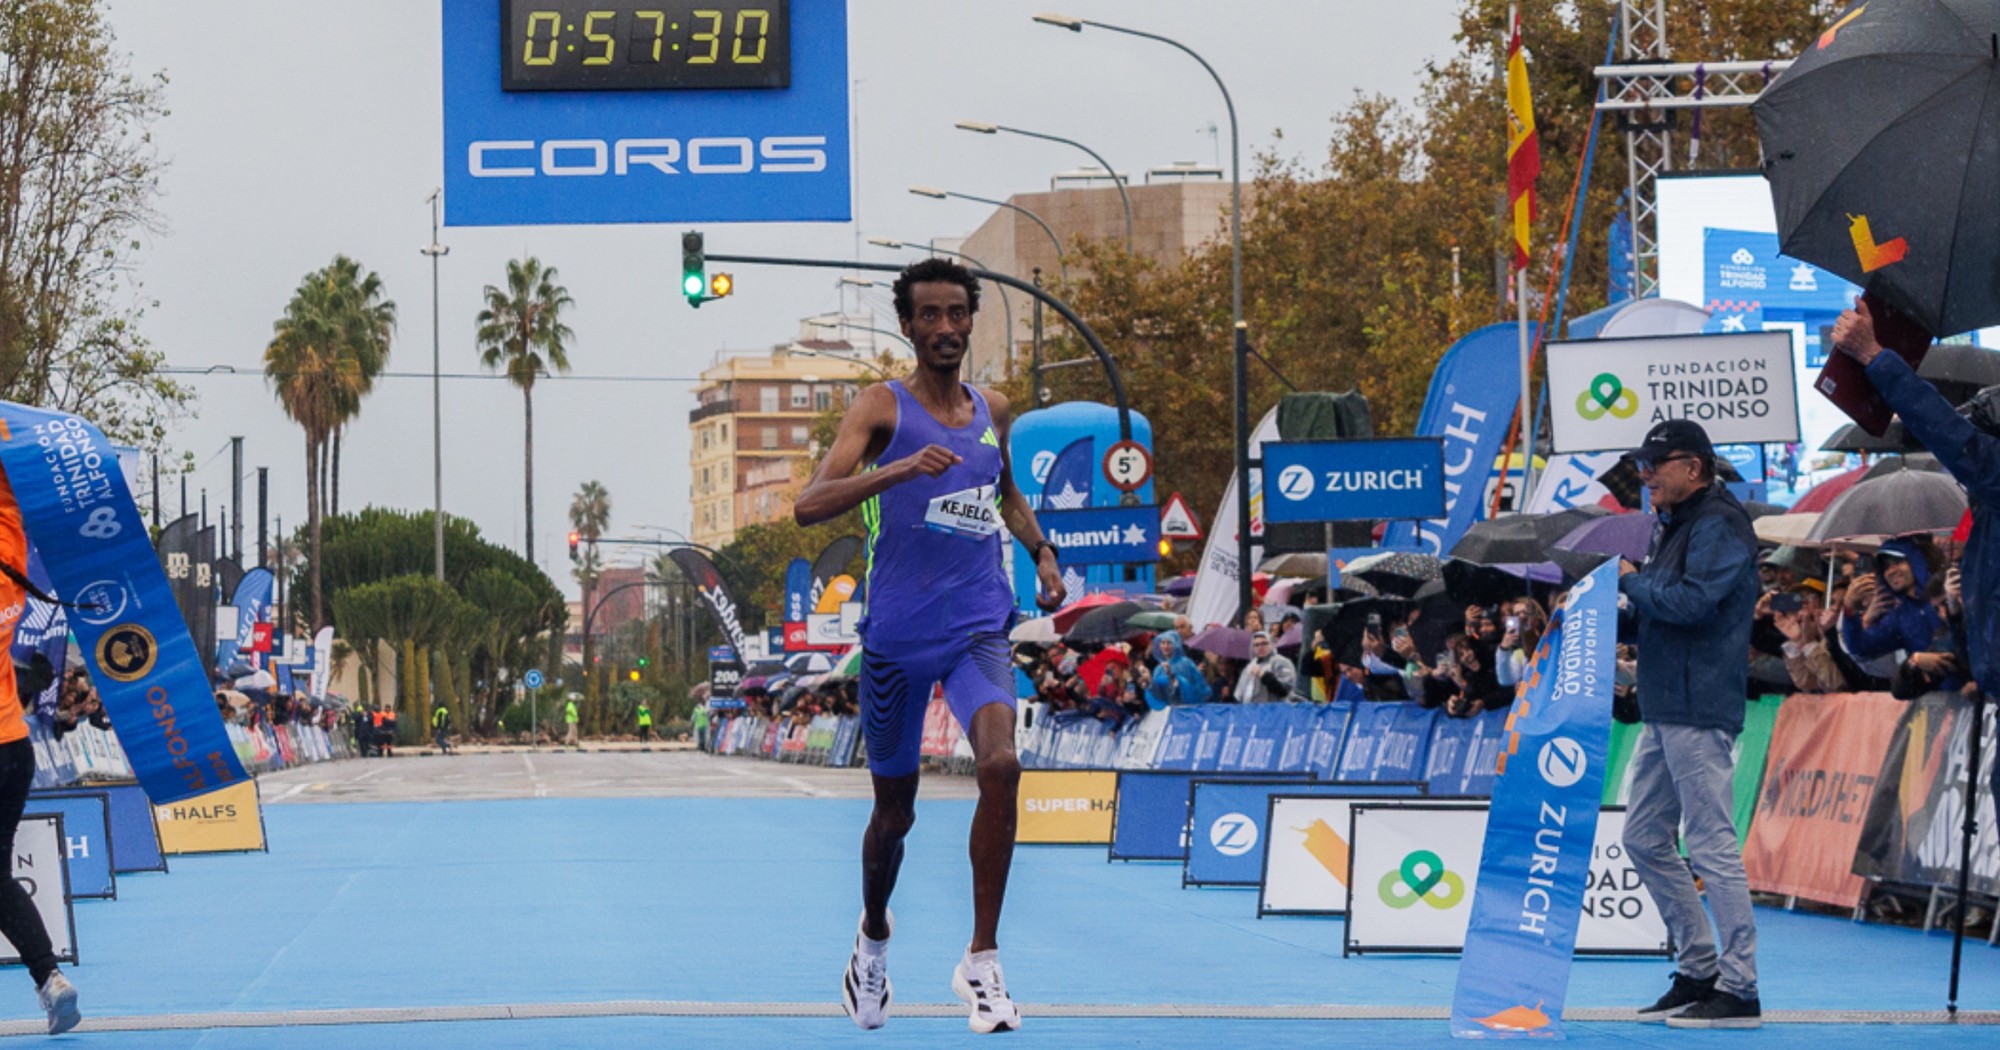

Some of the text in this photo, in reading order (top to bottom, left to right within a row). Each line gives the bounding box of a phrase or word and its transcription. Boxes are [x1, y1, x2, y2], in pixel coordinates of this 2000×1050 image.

[523, 10, 770, 66] 0:57:30
[468, 135, 827, 178] COROS
[1720, 270, 1766, 281] TRINIDAD
[1720, 279, 1766, 289] ALFONSO
[1647, 358, 1767, 376] FUNDACIÓN
[1647, 376, 1768, 401] TRINIDAD
[1650, 399, 1770, 423] ALFONSO
[33, 424, 76, 513] FUNDACIÓN
[48, 419, 96, 509] TRINIDAD
[65, 417, 115, 499] ALFONSO
[1325, 469, 1422, 492] ZURICH
[940, 499, 995, 524] KEJELC
[1050, 525, 1120, 548] luanvi
[1564, 609, 1582, 695] TRINIDAD
[1584, 608, 1598, 697] FUNDACIÓN
[714, 670, 739, 684] 200
[146, 686, 206, 790] ALFONSO
[1519, 800, 1567, 935] ZURICH
